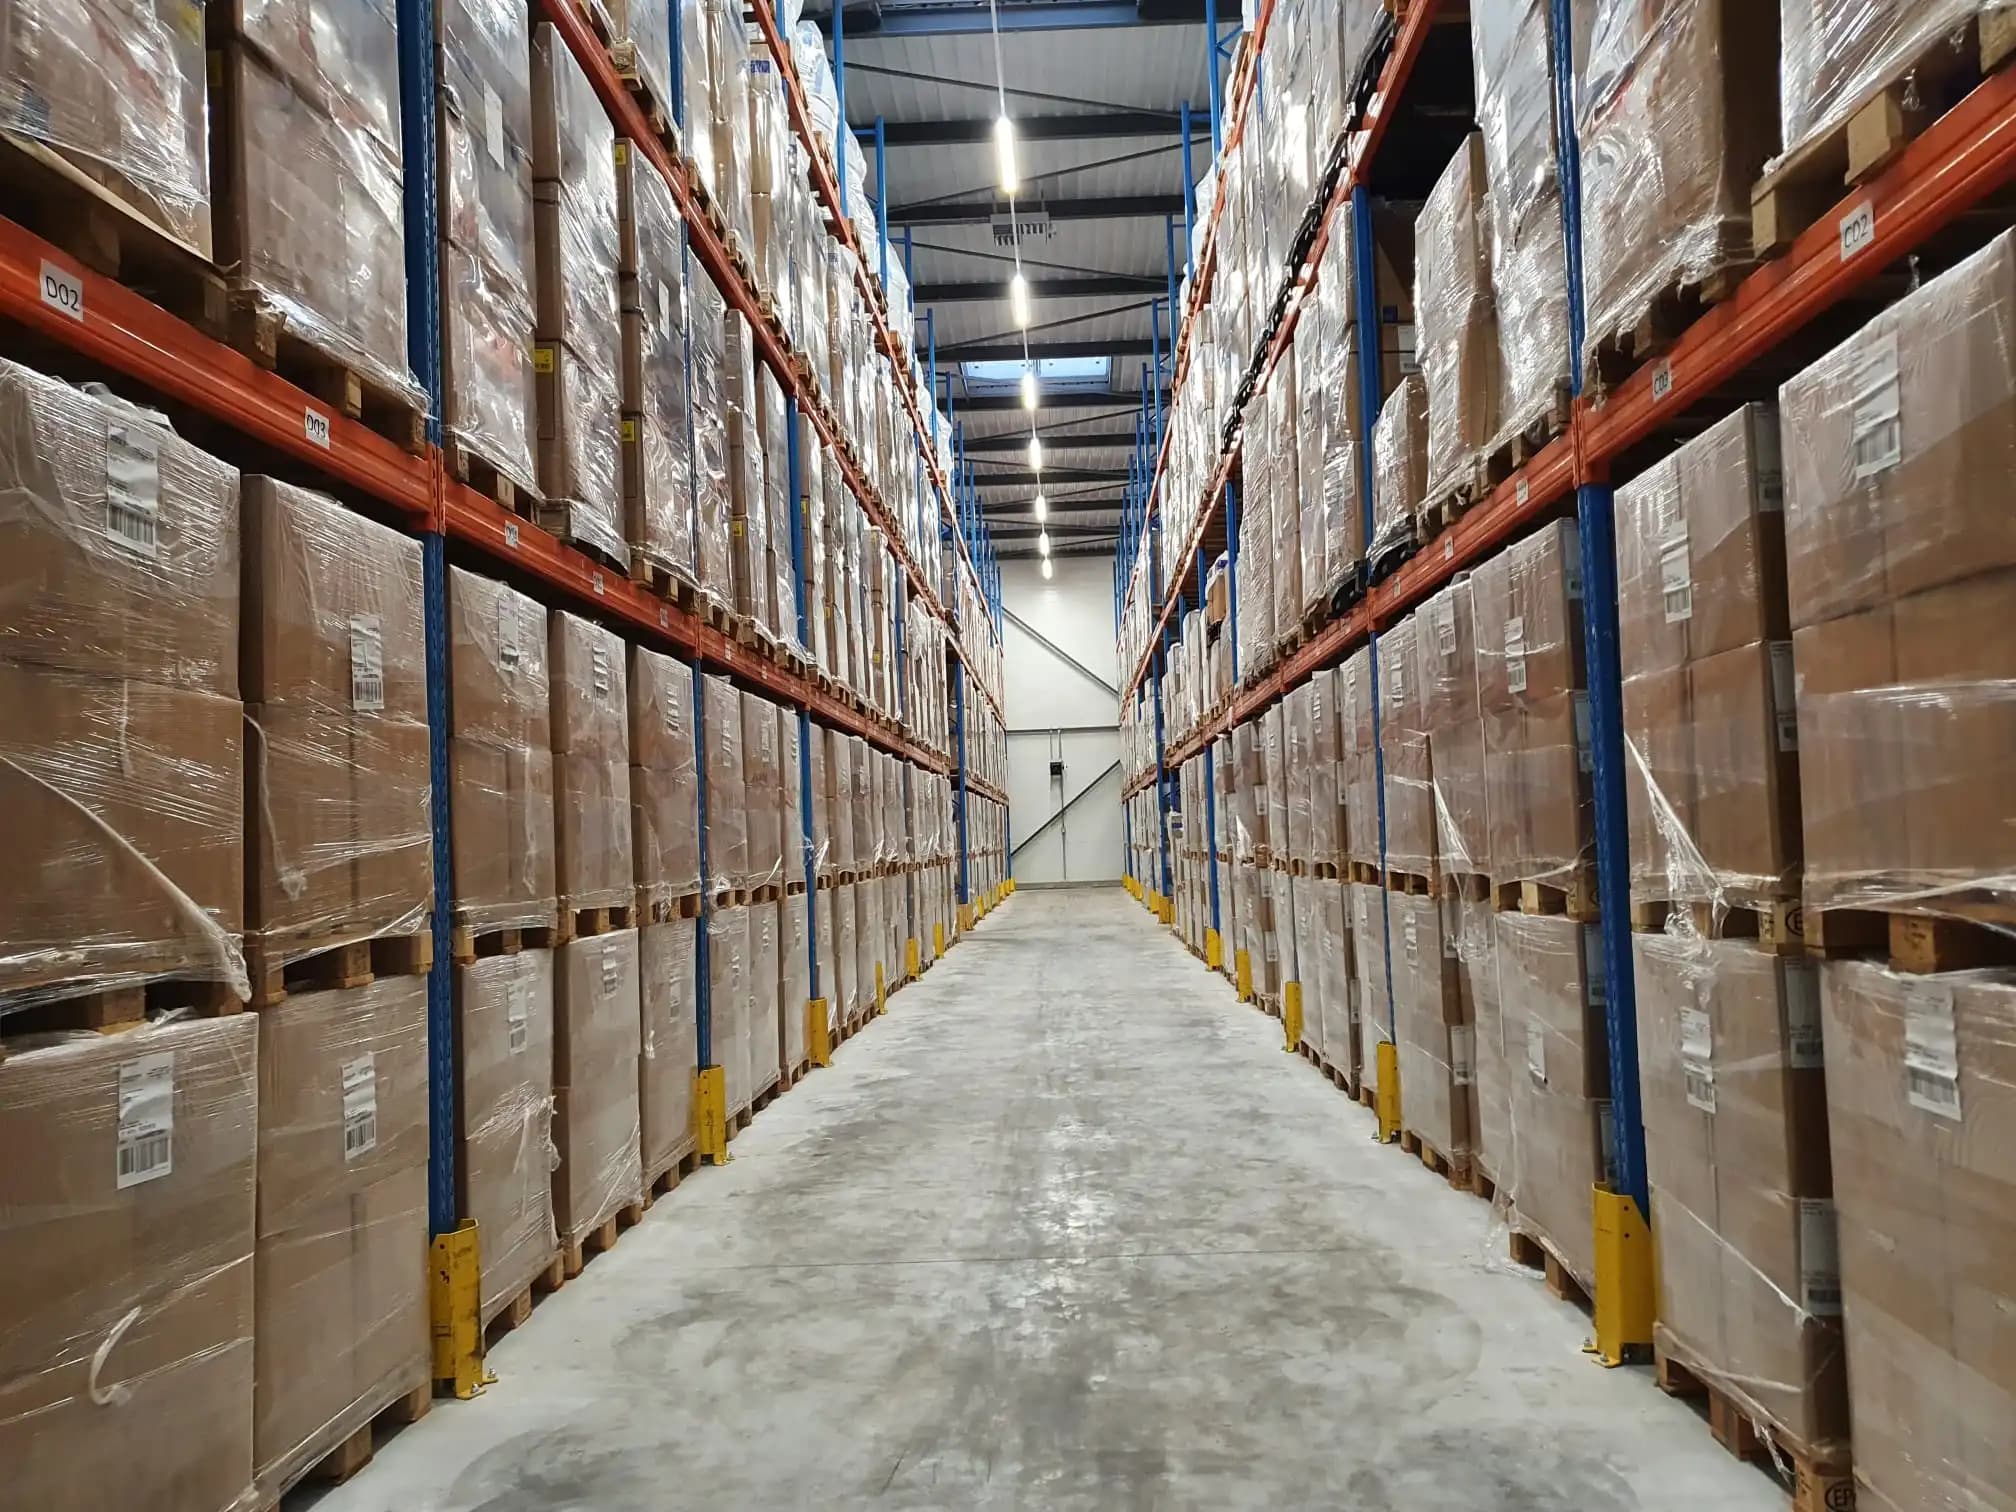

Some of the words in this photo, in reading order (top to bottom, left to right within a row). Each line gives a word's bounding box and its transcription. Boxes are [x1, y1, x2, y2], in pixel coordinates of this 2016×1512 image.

[1844, 213, 1868, 248] C02
[46, 275, 80, 312] D02
[307, 414, 326, 439] D03
